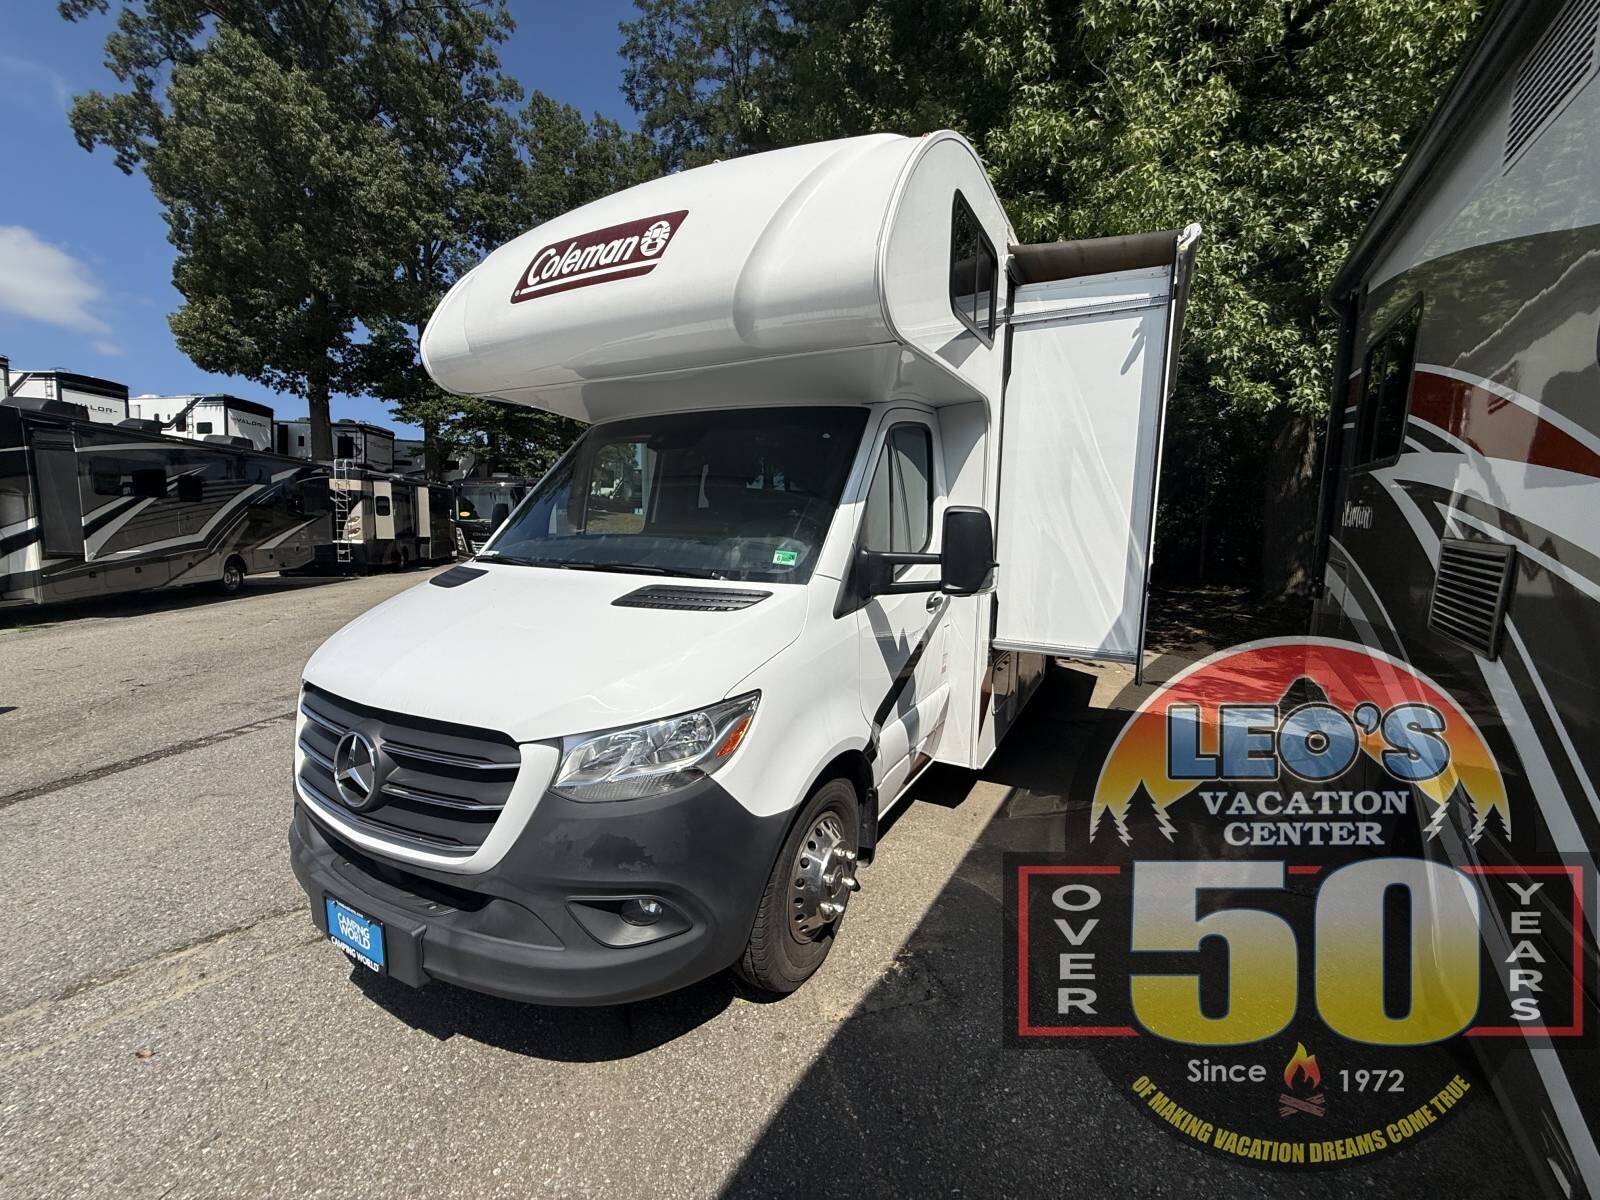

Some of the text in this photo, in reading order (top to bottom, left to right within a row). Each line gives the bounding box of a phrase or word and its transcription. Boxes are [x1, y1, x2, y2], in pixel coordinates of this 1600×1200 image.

[527, 235, 639, 286] Coleman
[331, 935, 380, 972] CAMPING WORLD
[339, 922, 371, 950] WORLD
